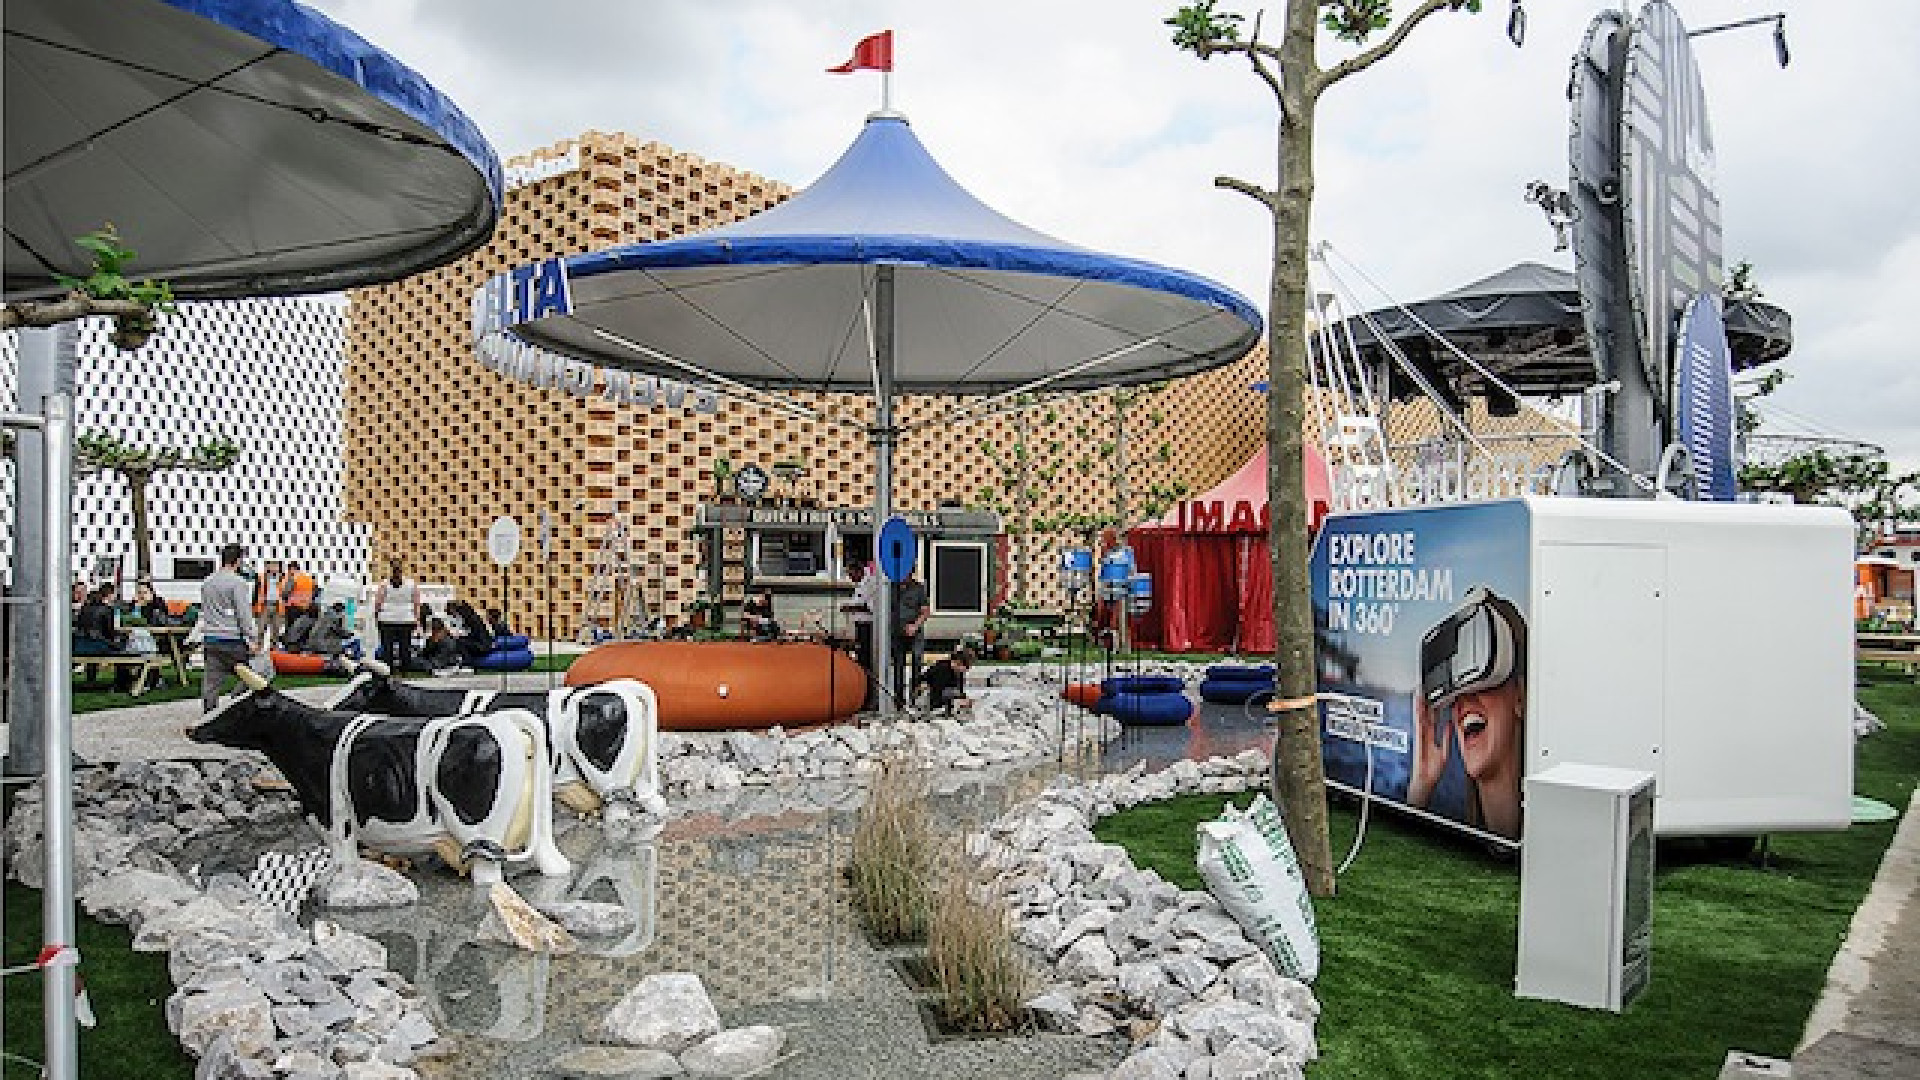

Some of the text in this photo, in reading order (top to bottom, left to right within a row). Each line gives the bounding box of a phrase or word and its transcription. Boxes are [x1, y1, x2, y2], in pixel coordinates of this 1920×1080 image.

[1330, 533, 1414, 565] EXPLORE
[1328, 569, 1453, 603] ROTTERDAM
[1328, 603, 1348, 631] IN
